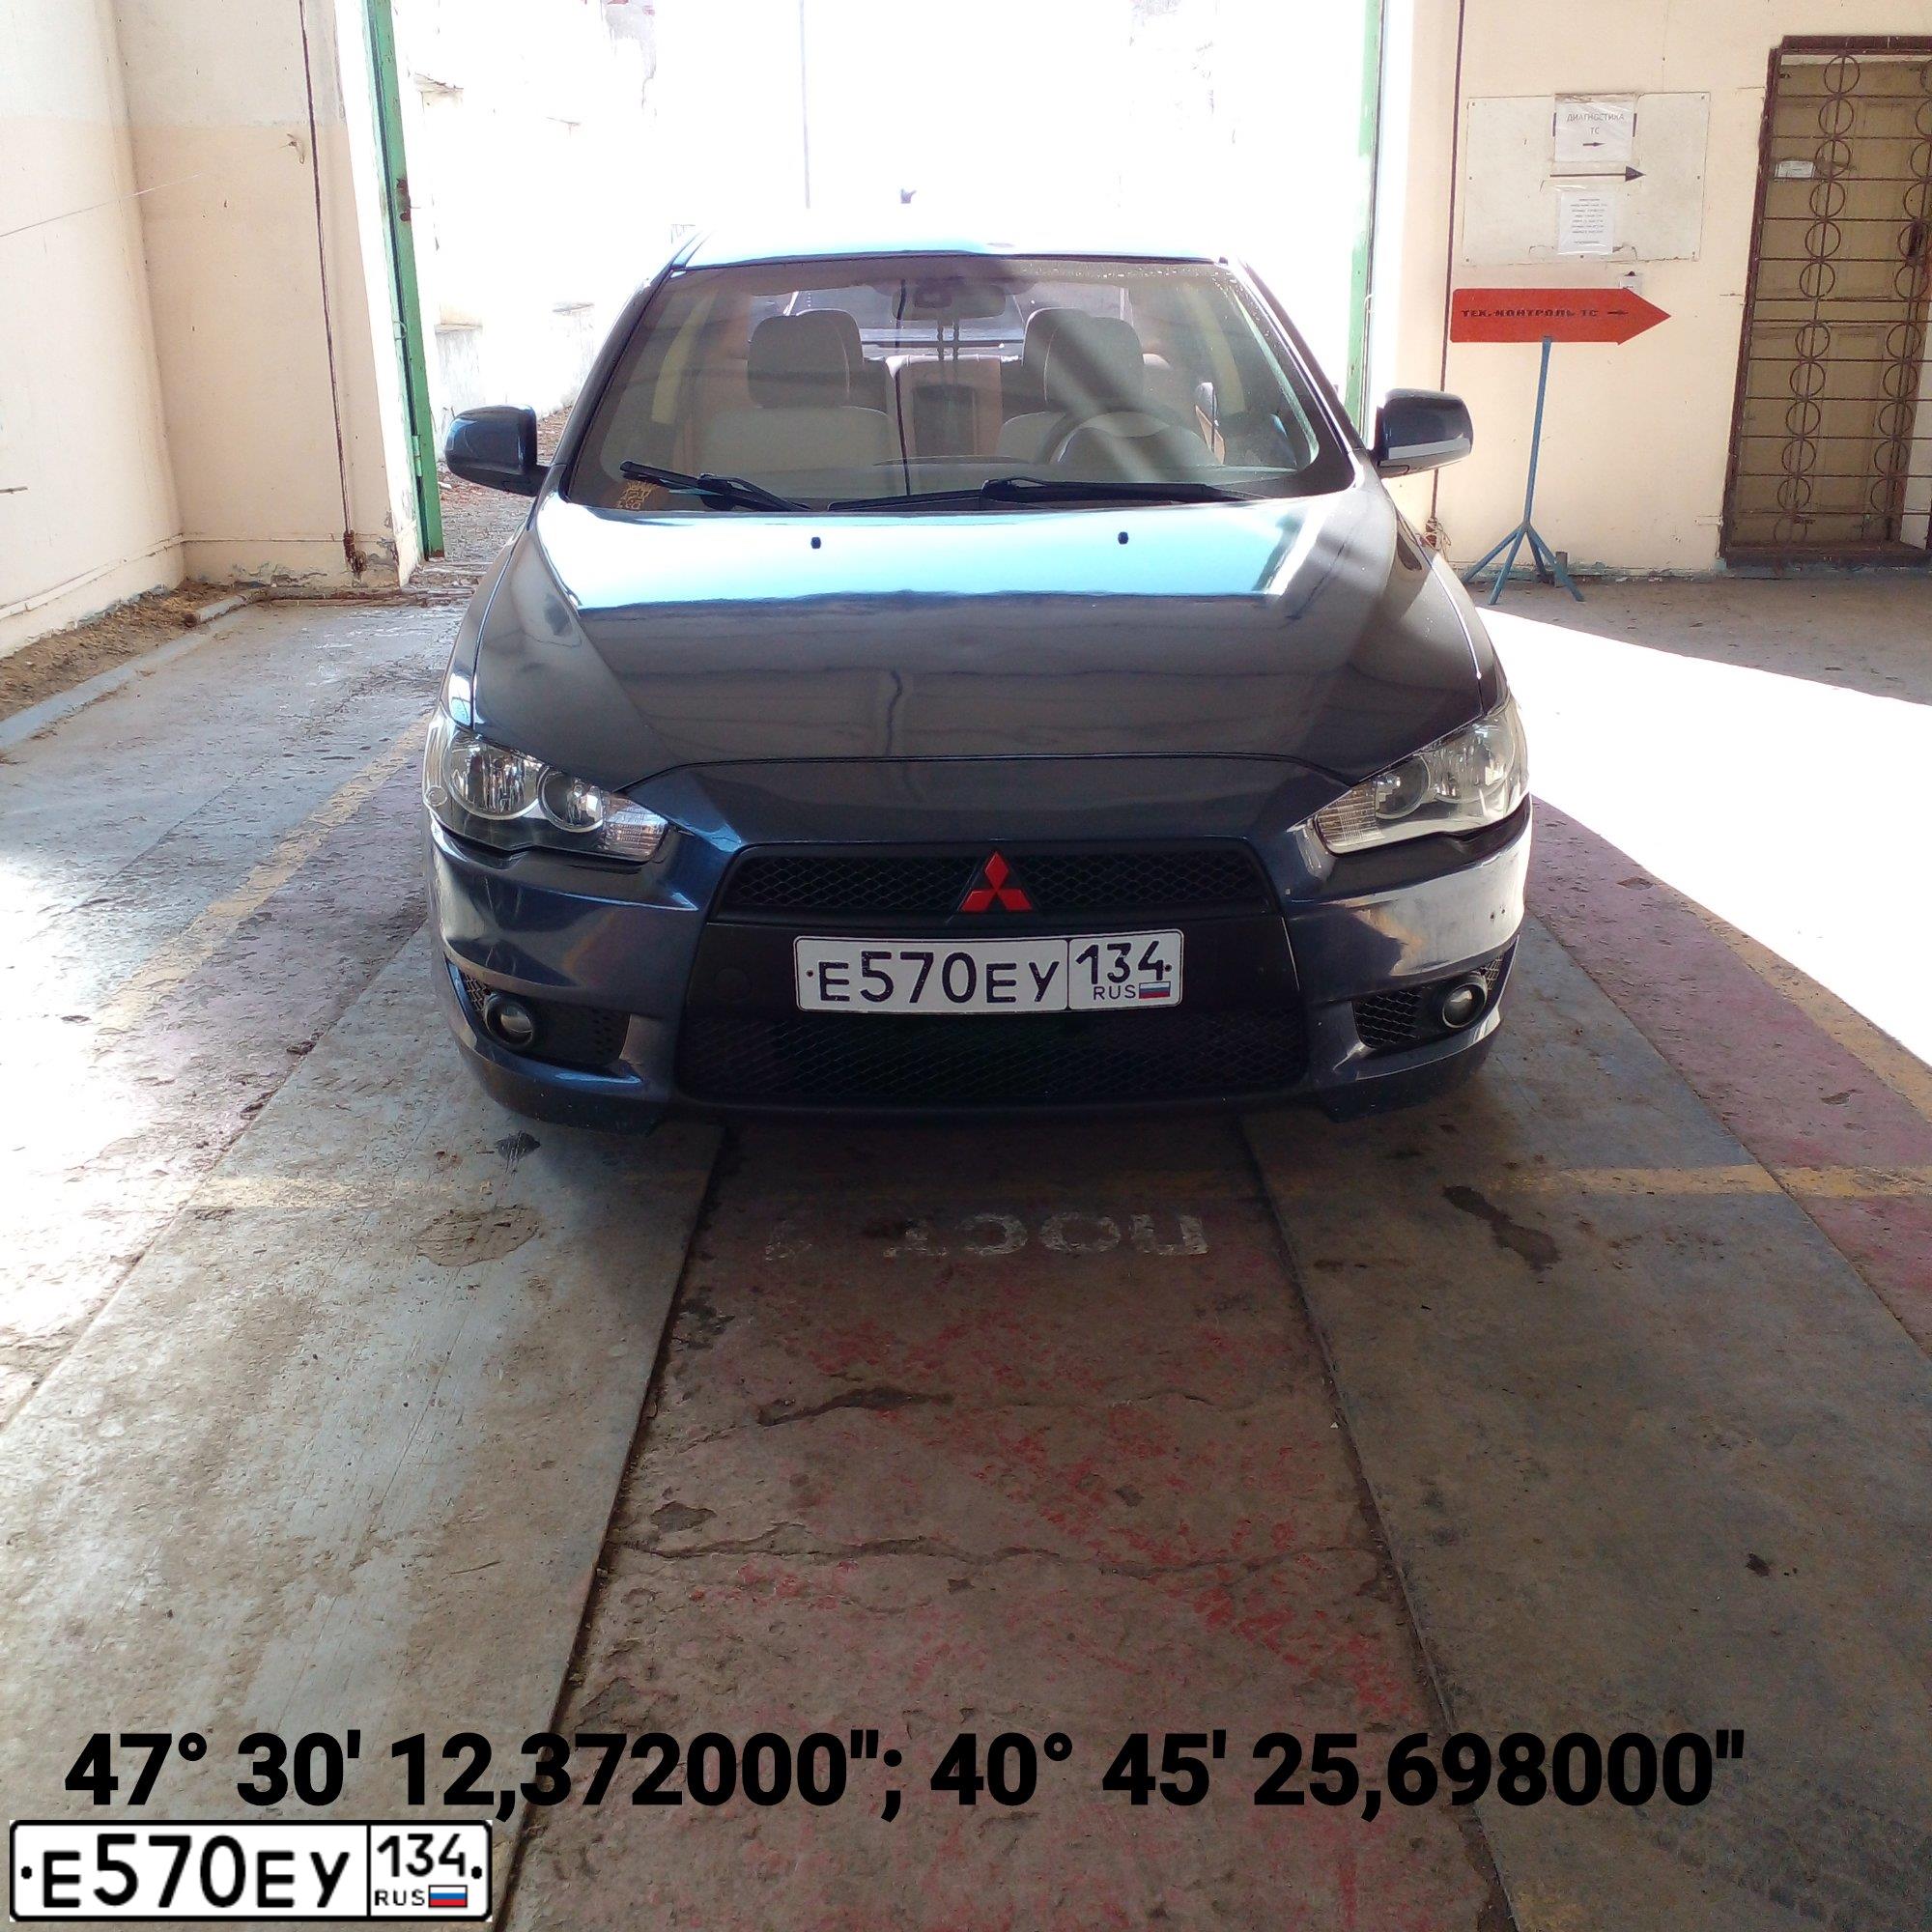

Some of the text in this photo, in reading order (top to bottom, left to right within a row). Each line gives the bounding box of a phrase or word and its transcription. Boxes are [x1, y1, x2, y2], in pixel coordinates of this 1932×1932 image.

[1566, 112, 1625, 123] ДИАГНОСТИКА
[1590, 127, 1601, 135] ТС
[1580, 308, 1599, 318] ТС
[818, 940, 1165, 1004] Е570ЕУ 134
[1093, 983, 1137, 1001] RUS
